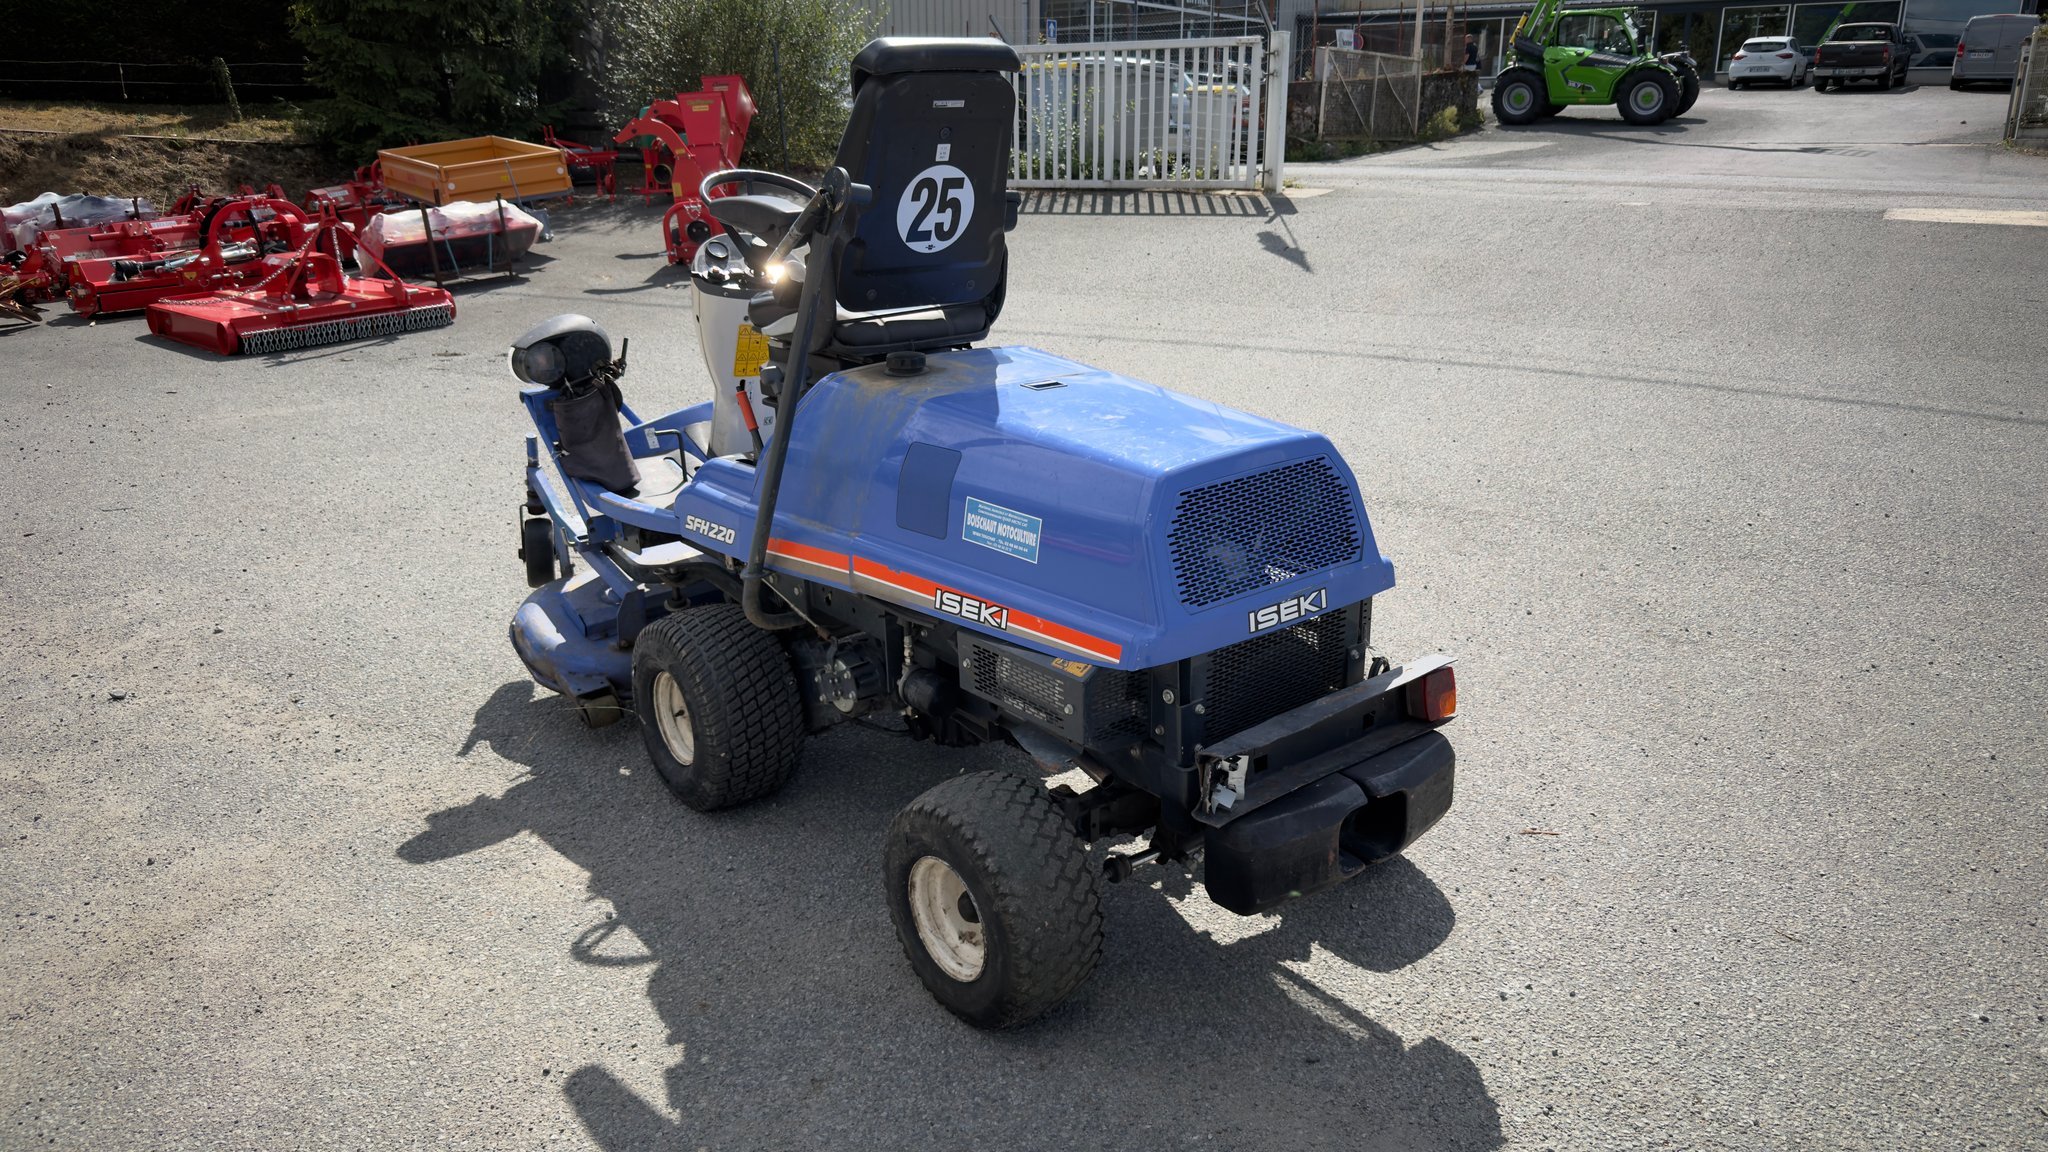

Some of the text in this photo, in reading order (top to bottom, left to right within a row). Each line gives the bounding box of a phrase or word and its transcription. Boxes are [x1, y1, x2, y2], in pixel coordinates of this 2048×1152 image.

[906, 177, 965, 242] 25
[685, 514, 736, 545] SFH220
[967, 512, 998, 535] BOISCHAUT
[997, 522, 1037, 547] MOTOCULTURE
[935, 588, 1008, 631] ISEKI
[1248, 587, 1328, 633] ISEKI
